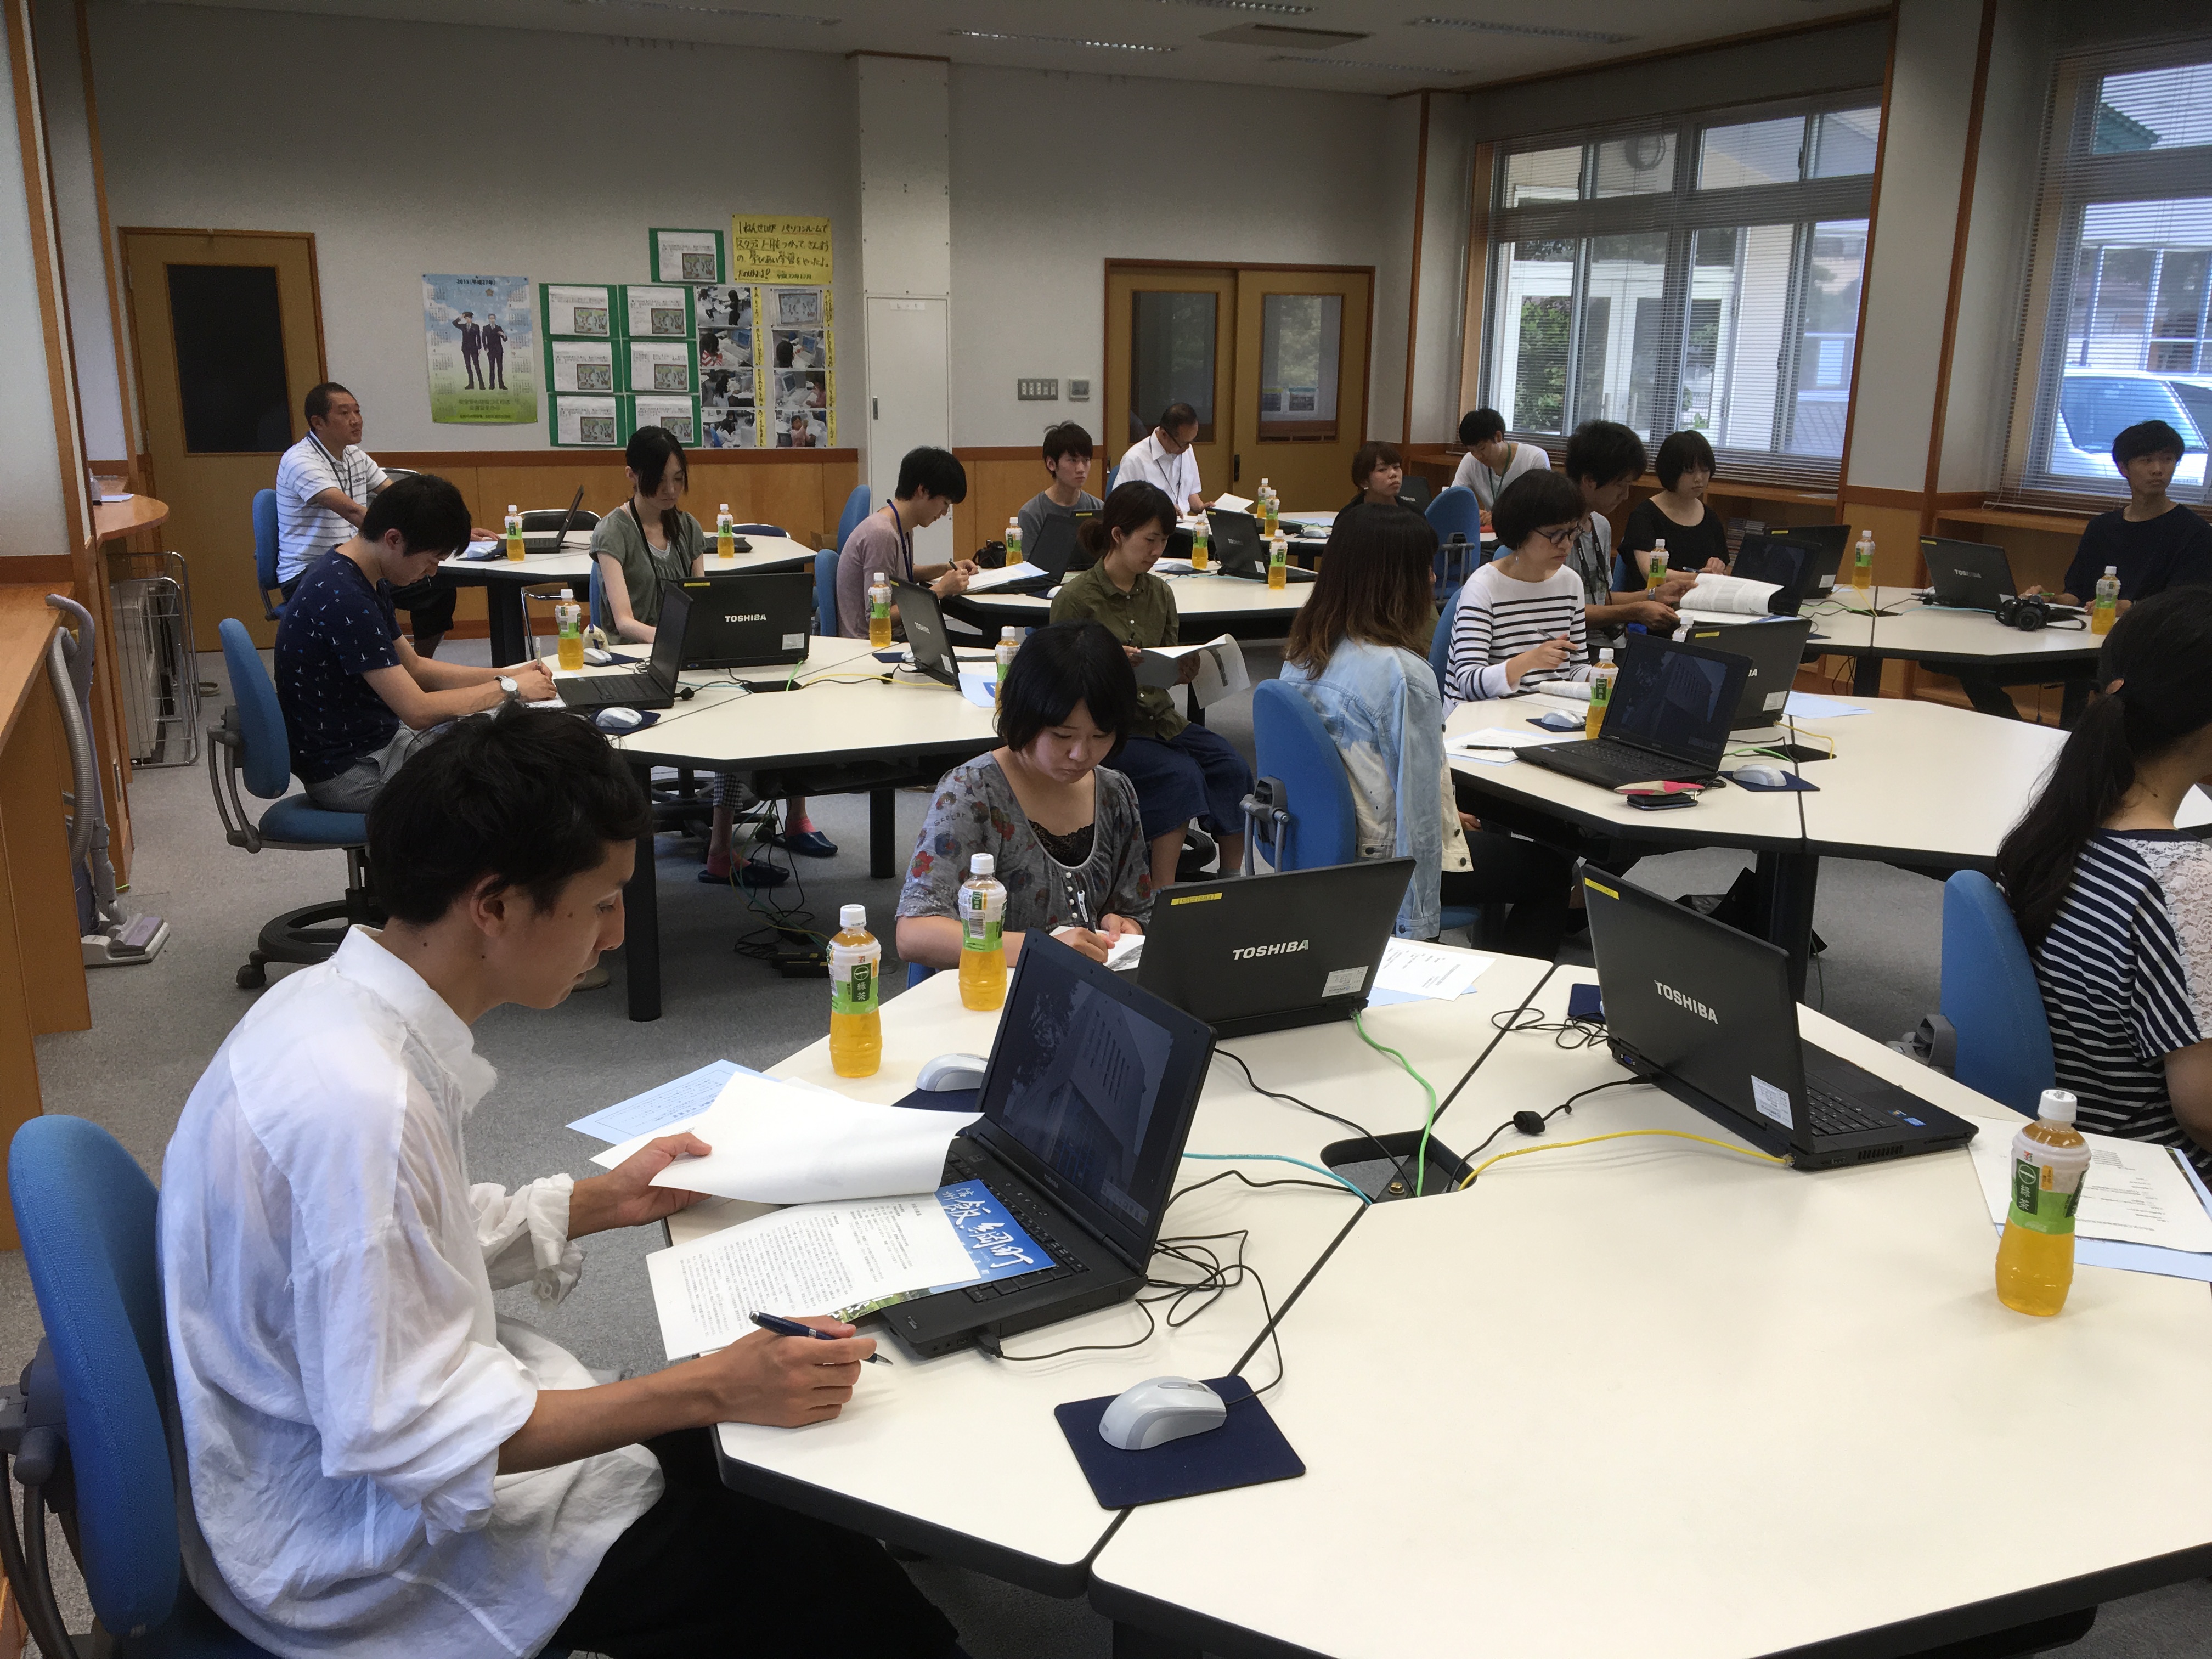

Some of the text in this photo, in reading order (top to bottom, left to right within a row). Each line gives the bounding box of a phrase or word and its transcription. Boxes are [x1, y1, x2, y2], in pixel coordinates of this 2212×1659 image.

[724, 614, 766, 623] TOSHIBA
[1233, 939, 1309, 960] TOSHIBA
[1654, 979, 1719, 1025] TOSHIBA
[943, 1199, 1034, 1268] 飯綱町
